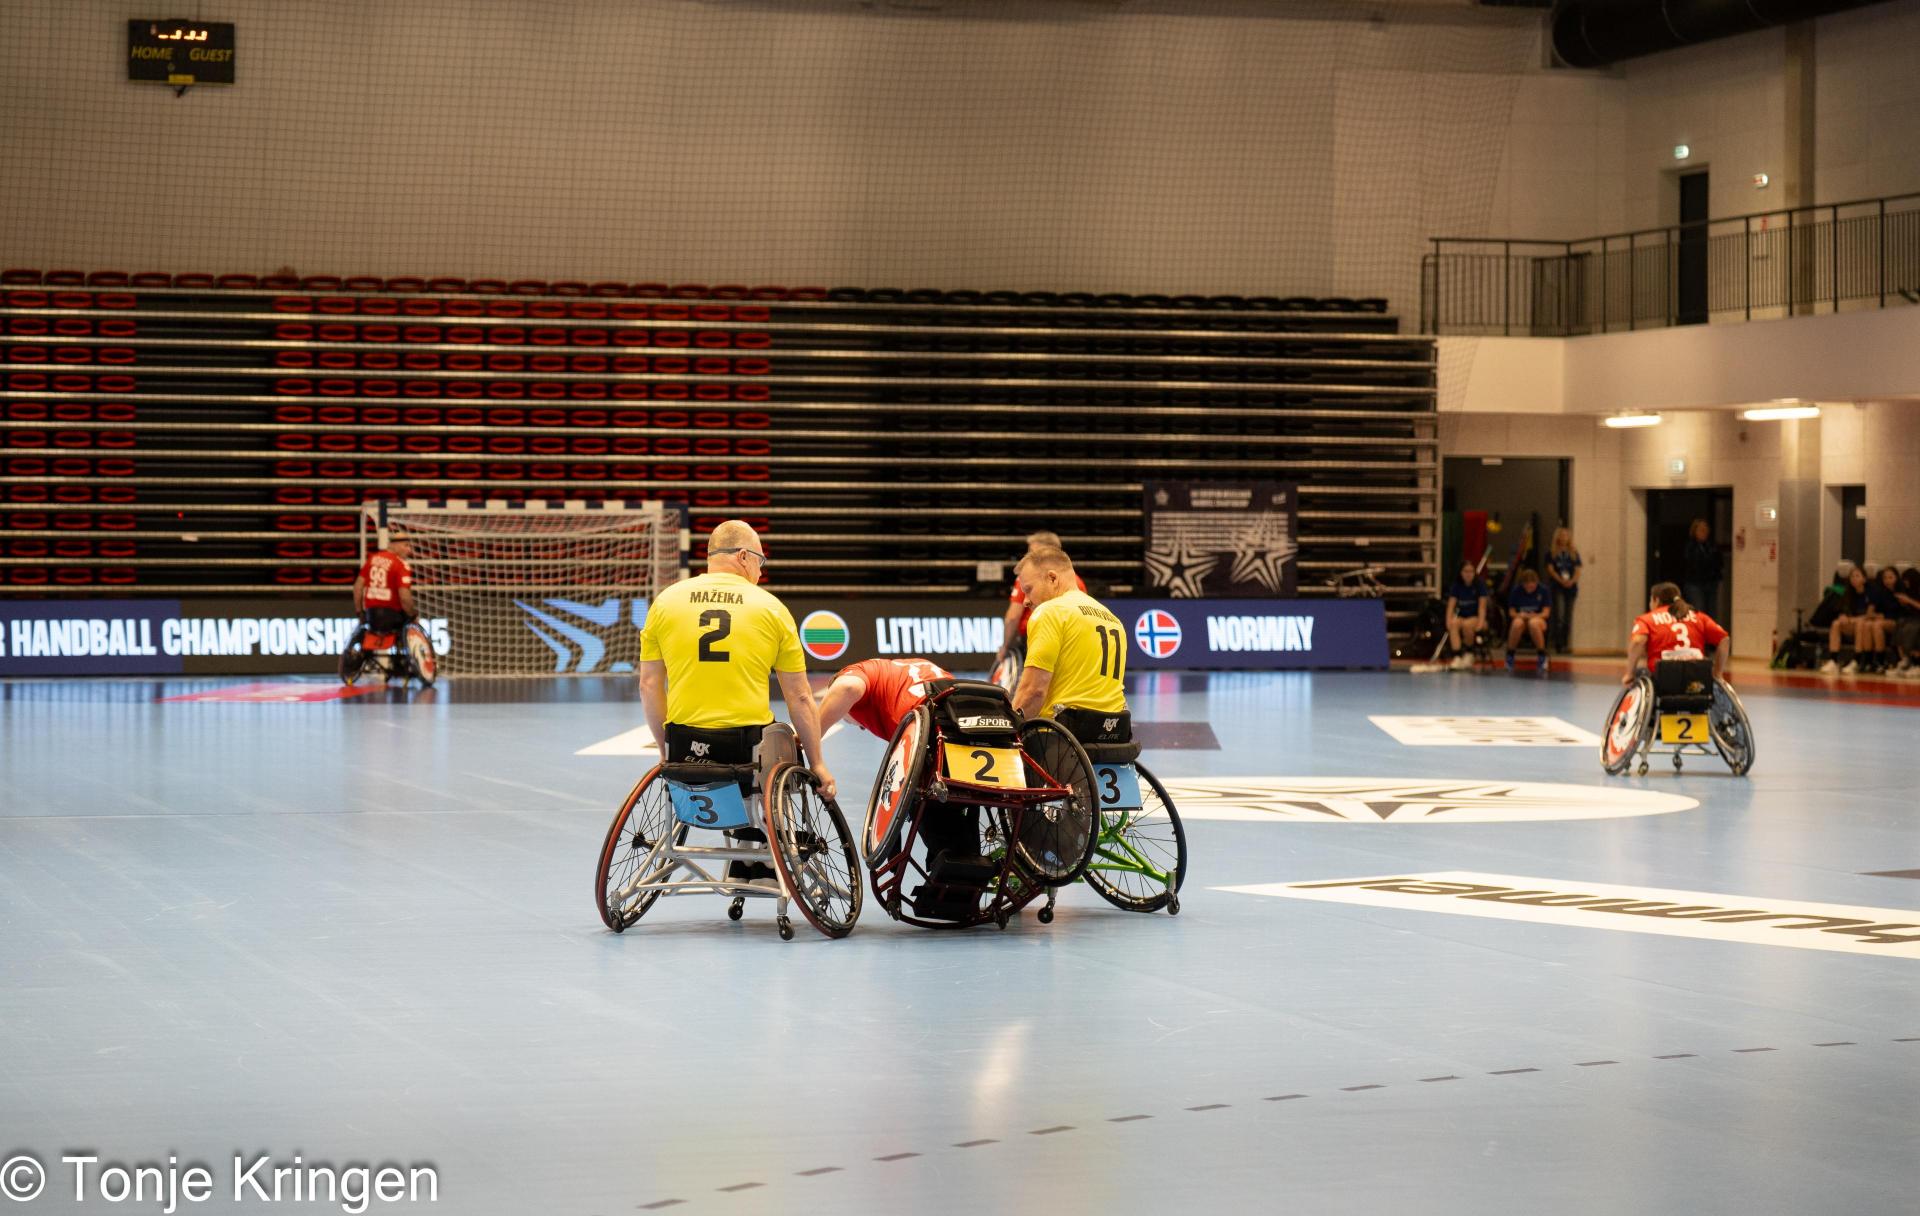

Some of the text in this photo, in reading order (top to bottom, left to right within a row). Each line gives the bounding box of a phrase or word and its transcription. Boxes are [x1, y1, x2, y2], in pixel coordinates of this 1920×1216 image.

[131, 46, 232, 62] HOME GUEST
[690, 589, 744, 605] MAŽEIKA
[10, 618, 158, 657] HANDBALL
[698, 609, 732, 662] 2
[1206, 616, 1314, 651] NORWAY
[1671, 623, 1691, 650] 3
[1095, 625, 1120, 680] 11
[979, 718, 1012, 728] SPORT
[1677, 718, 1693, 739] 2
[690, 740, 711, 757] RGK
[971, 750, 999, 783] 2
[1098, 767, 1121, 804] 3
[689, 795, 719, 824] 3
